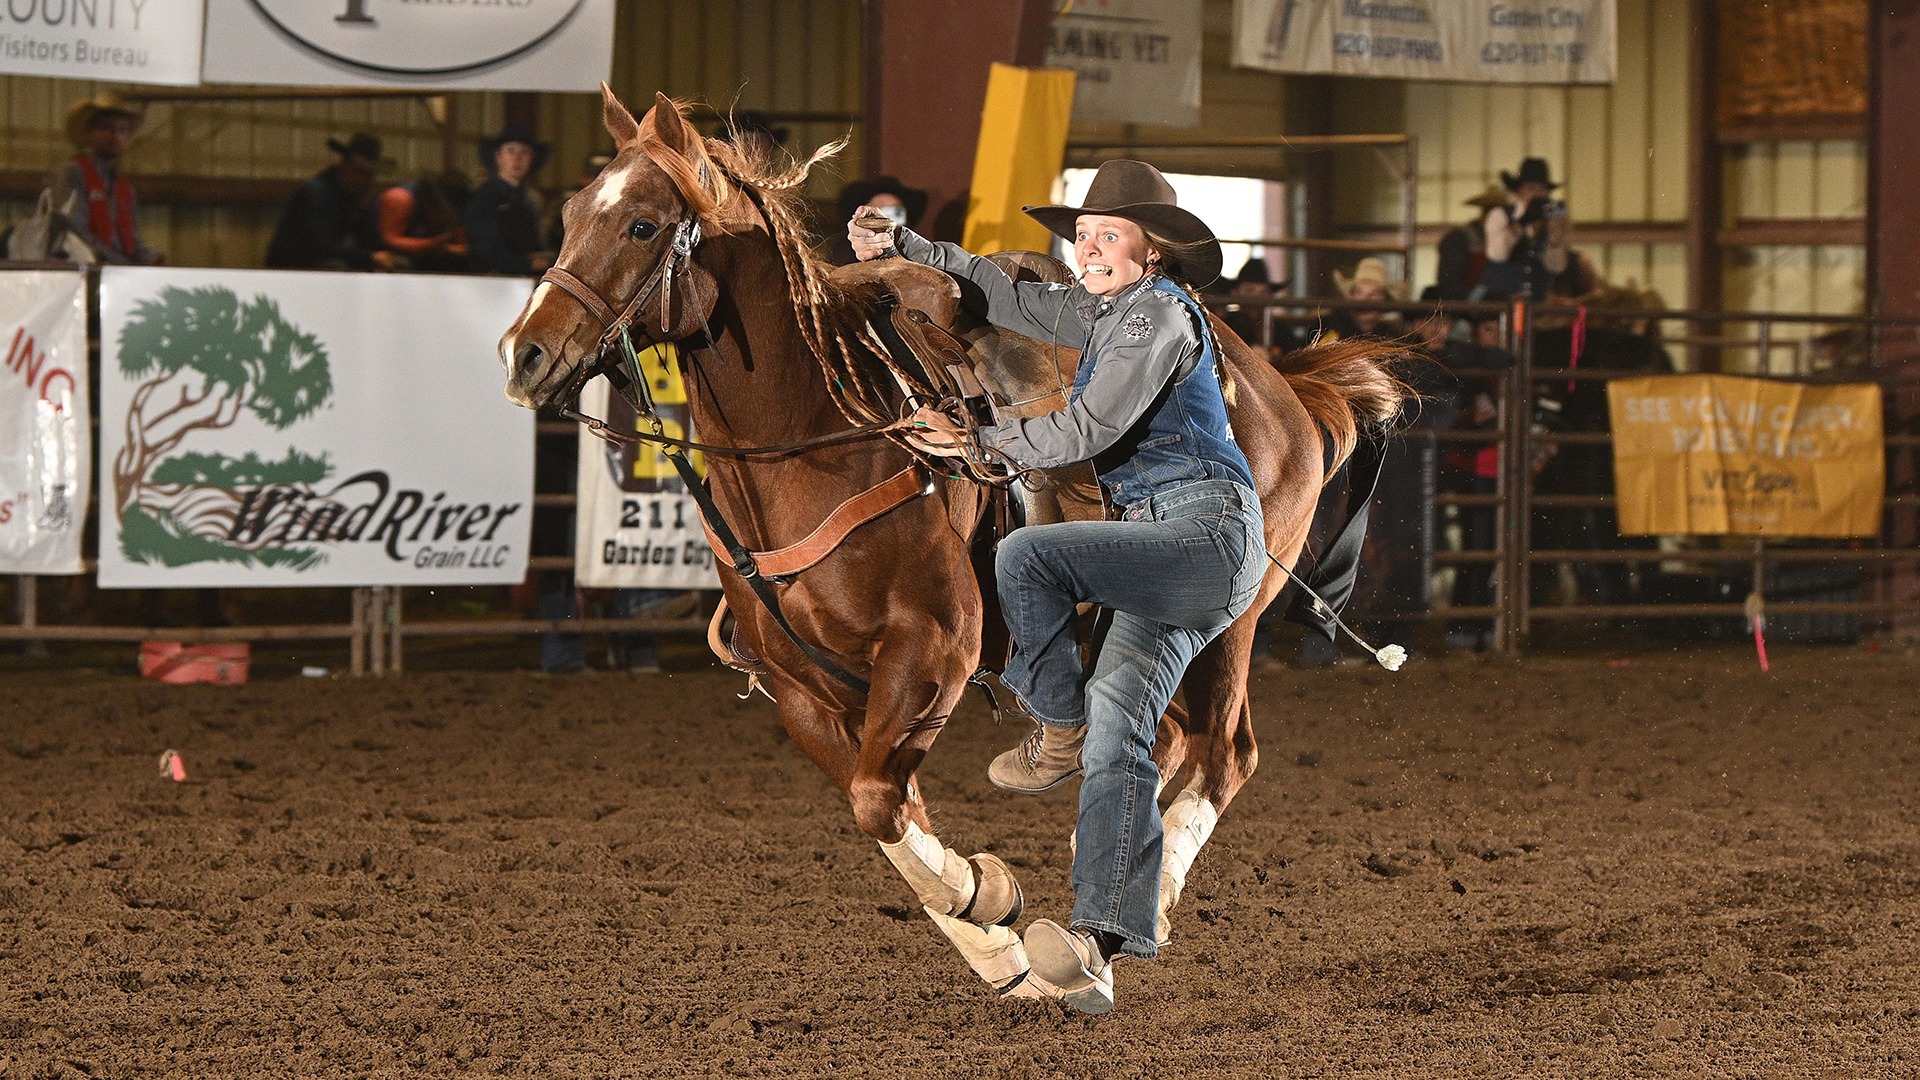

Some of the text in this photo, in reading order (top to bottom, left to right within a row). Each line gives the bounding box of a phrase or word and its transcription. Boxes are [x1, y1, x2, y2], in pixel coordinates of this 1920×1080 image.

[0, 0, 147, 30] OUNTY
[75, 38, 149, 67] Bureau
[1625, 396, 1672, 423] SEE
[226, 469, 521, 562] WindRiver
[620, 500, 685, 529] 211
[414, 545, 511, 569] Grain LLC
[603, 540, 676, 565] Garden
